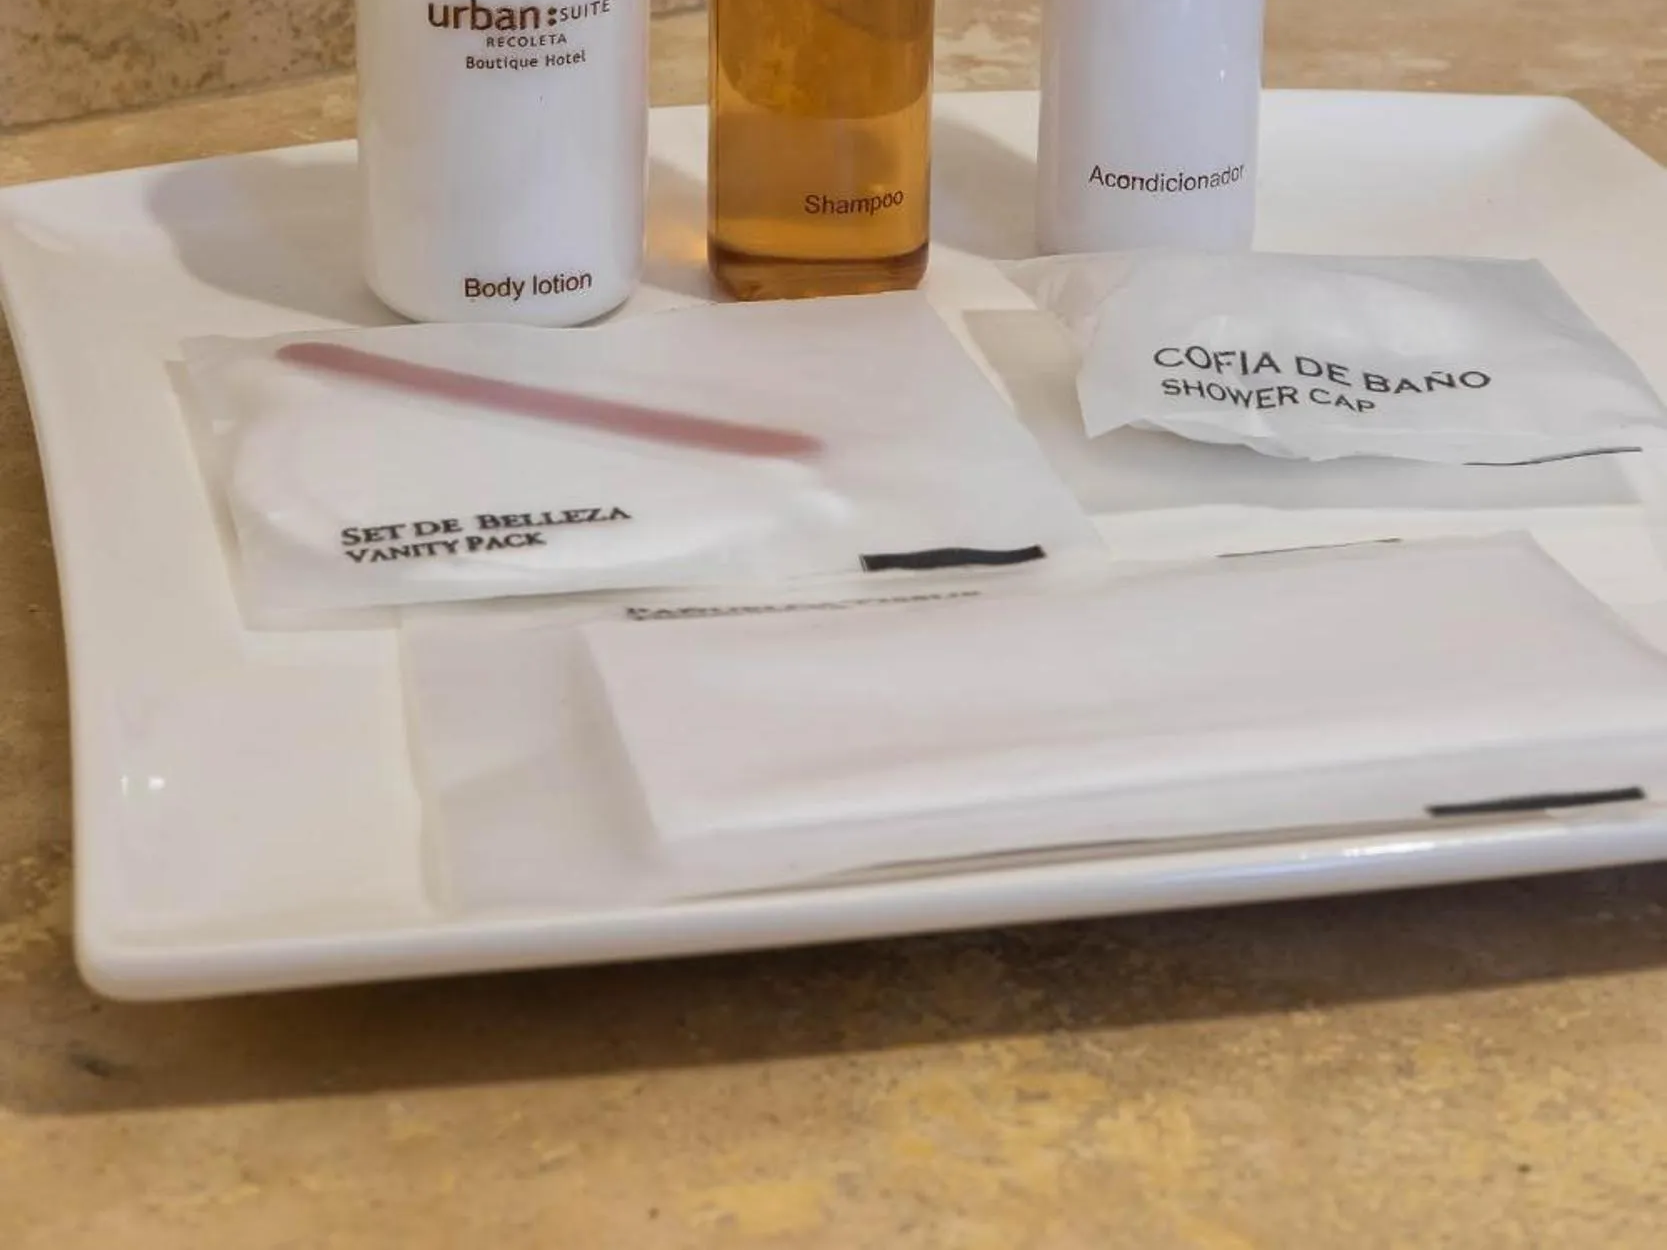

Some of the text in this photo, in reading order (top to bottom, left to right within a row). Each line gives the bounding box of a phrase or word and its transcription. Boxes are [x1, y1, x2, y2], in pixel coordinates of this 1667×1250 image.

[486, 33, 568, 48] RECOLETA
[466, 49, 587, 70] Boutique Hotel
[1088, 164, 1245, 193] Acondicionador
[804, 190, 904, 217] Shampoo
[464, 272, 593, 301] Body lotion
[1153, 345, 1492, 395] COFIA DE BAÑO
[1161, 378, 1376, 414] SHOWER CAP
[341, 506, 632, 547] SET DE BELLEZA
[345, 531, 547, 564] VANITY PACK
